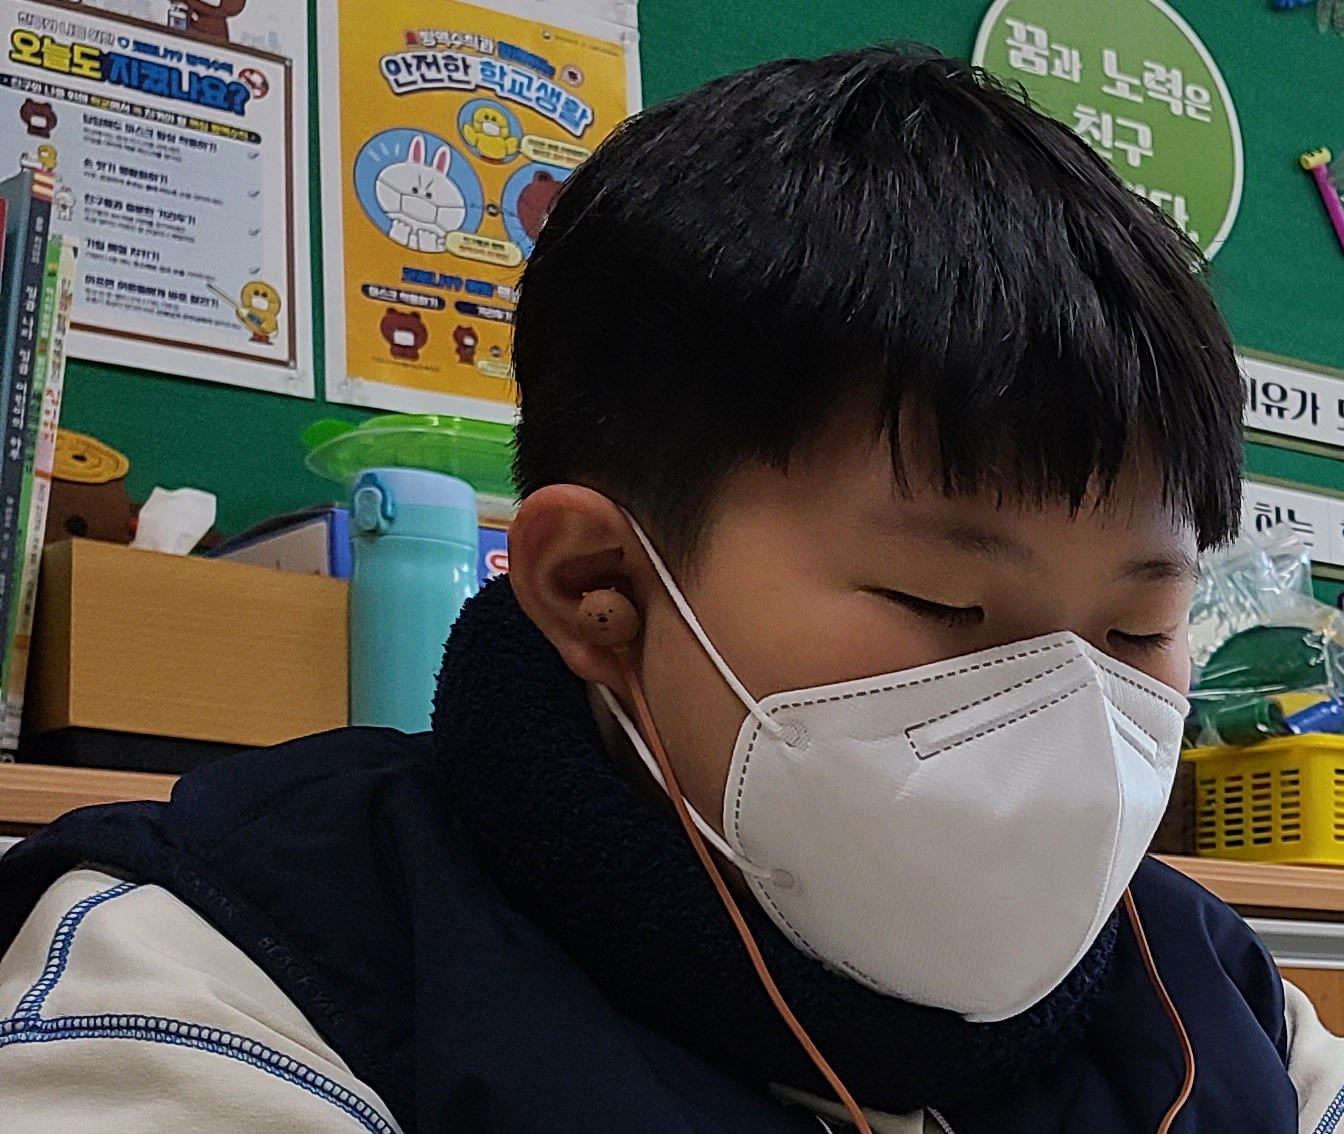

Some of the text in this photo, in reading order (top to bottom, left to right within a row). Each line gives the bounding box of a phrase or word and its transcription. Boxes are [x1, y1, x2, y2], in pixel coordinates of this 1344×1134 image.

[9, 29, 104, 80] 오늘도
[1005, 17, 1212, 123] 꿈과 노력은
[385, 53, 473, 88] 안전한
[479, 57, 590, 130] 학교생활
[1072, 103, 1153, 168] 친구
